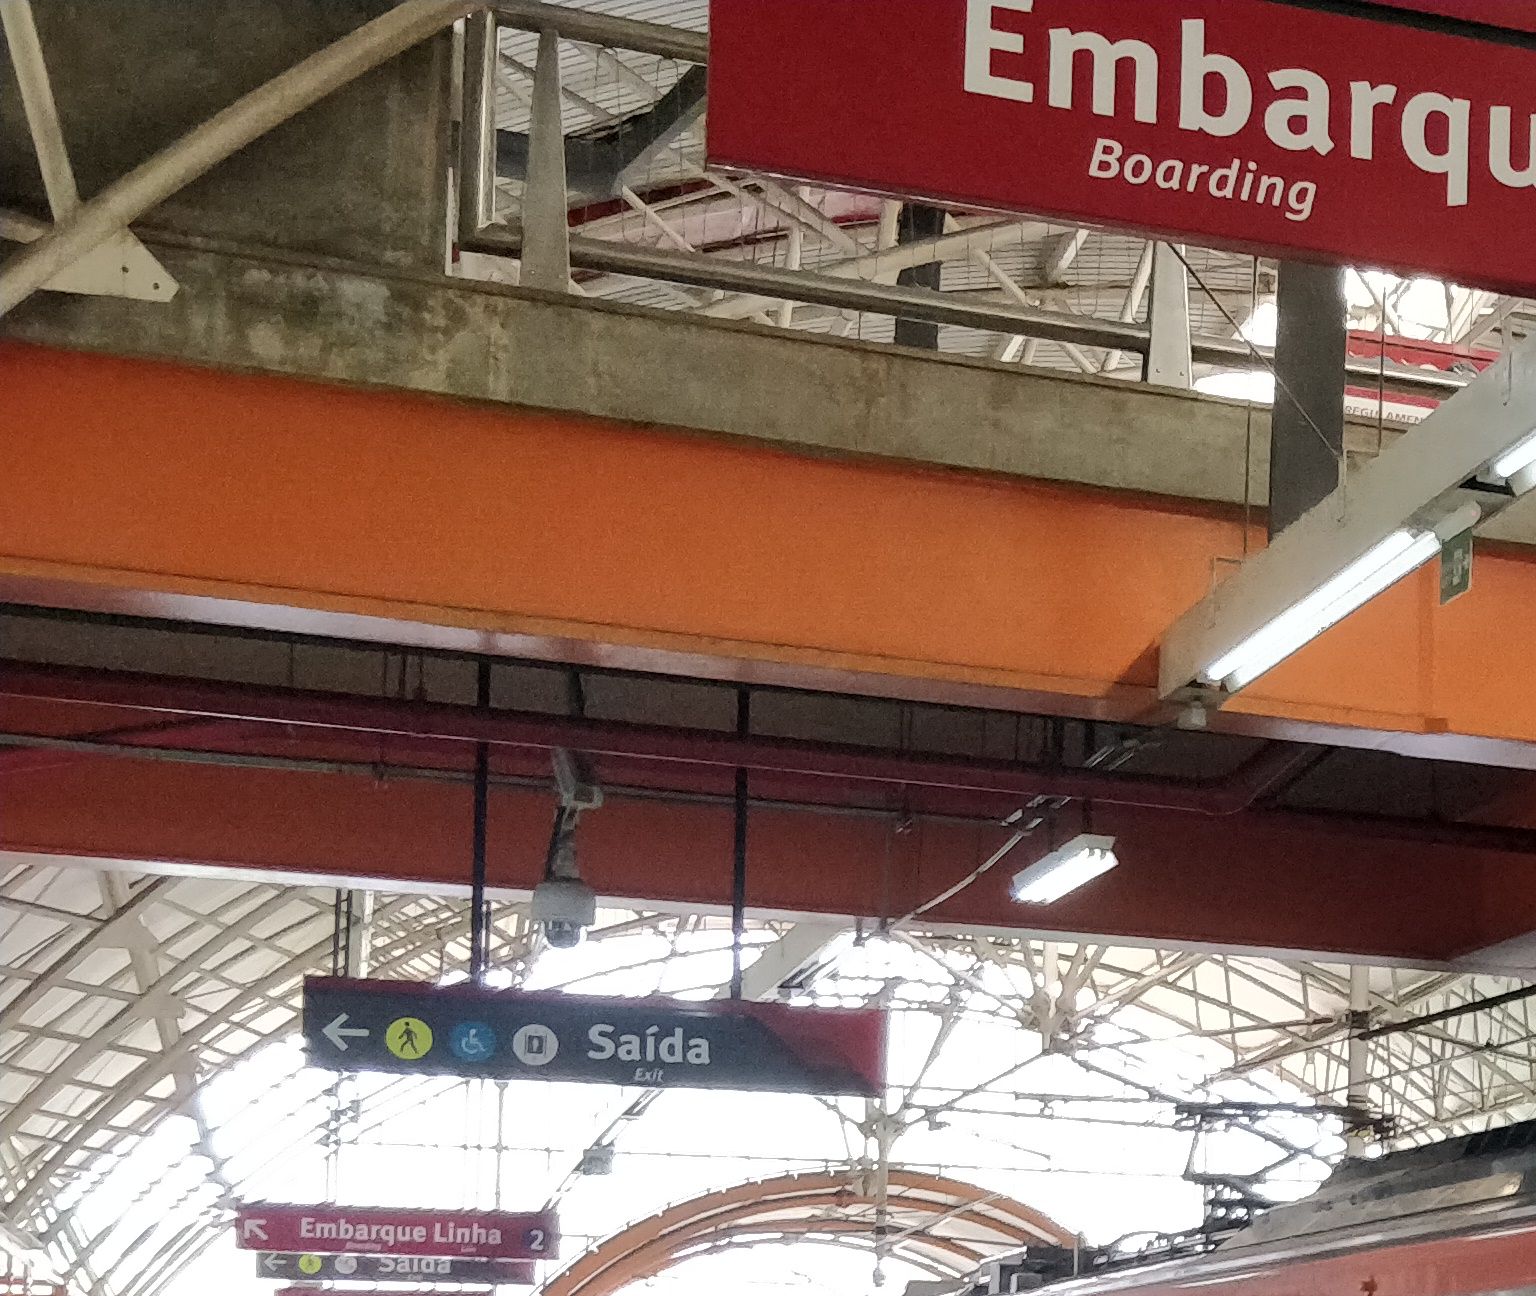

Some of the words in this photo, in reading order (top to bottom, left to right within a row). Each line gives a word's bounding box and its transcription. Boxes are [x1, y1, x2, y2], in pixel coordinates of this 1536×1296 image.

[1088, 137, 1317, 221] Boarding
[586, 1023, 711, 1065] Saída
[633, 1067, 665, 1082] Exit
[299, 1217, 427, 1246] Embarque
[433, 1221, 502, 1245] Linha
[529, 1229, 545, 1251] 2
